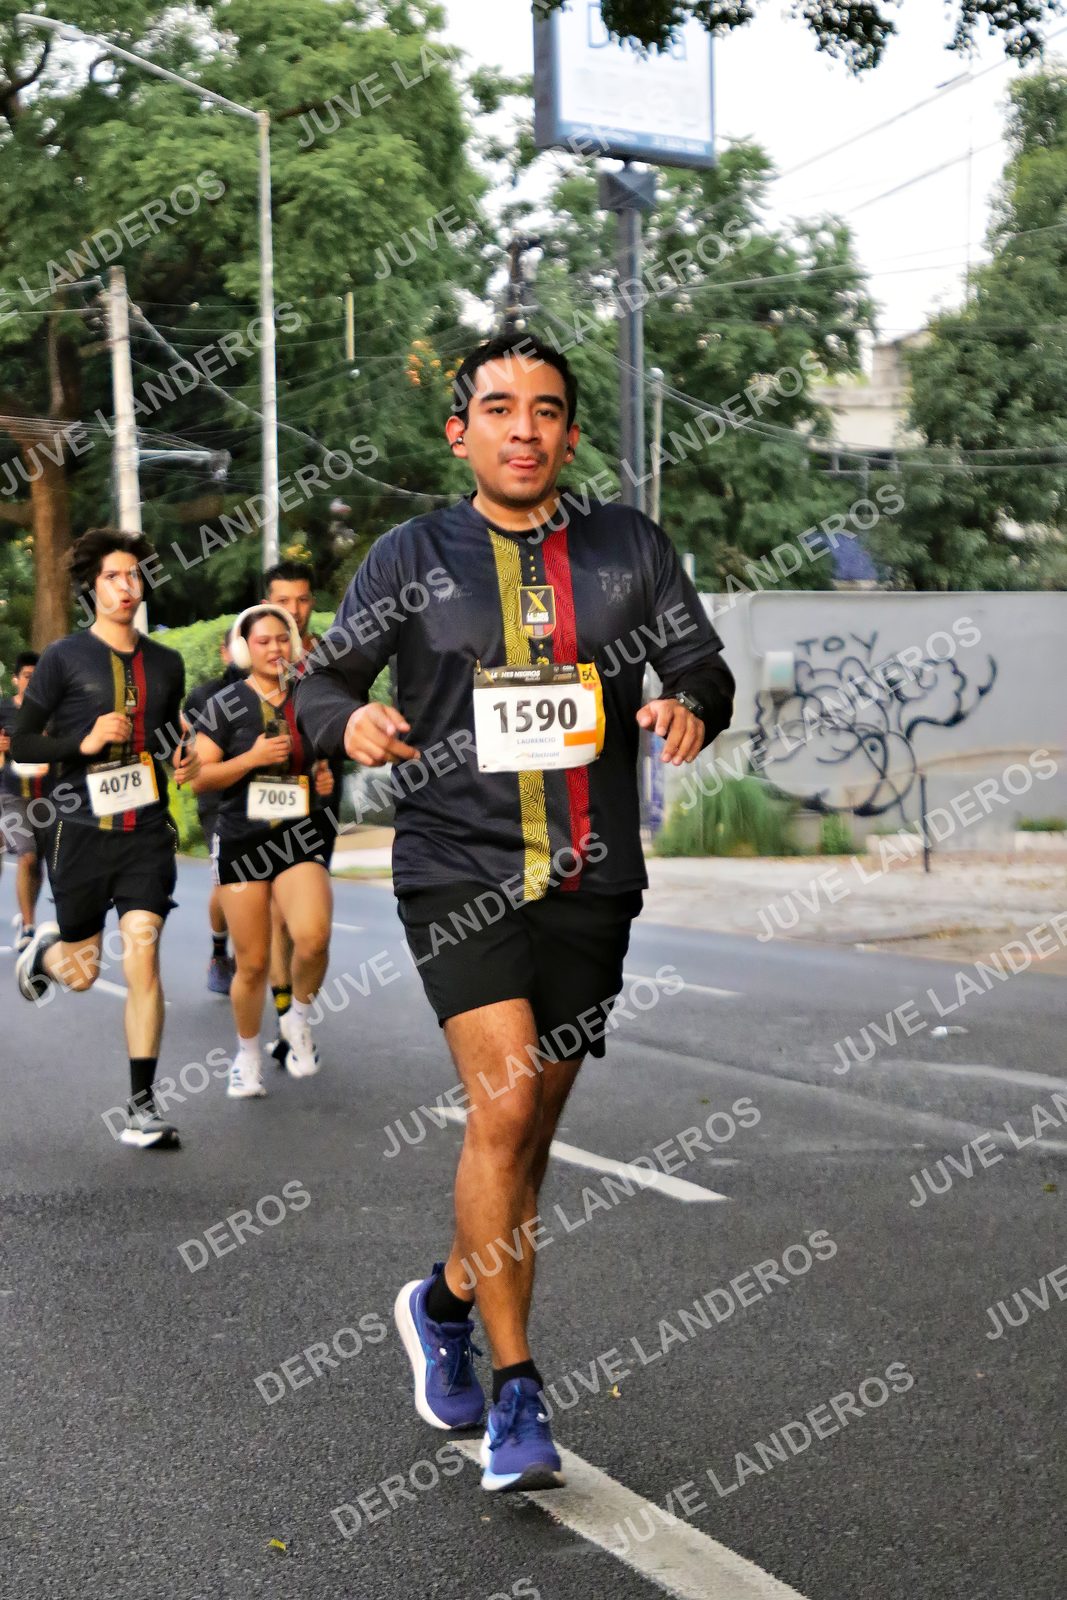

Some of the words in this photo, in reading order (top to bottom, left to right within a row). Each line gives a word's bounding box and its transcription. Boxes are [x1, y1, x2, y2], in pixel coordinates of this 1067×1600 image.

[795, 630, 878, 662] TOY
[493, 698, 577, 733] 1590
[99, 770, 142, 795] 4078
[258, 788, 296, 806] 7005
